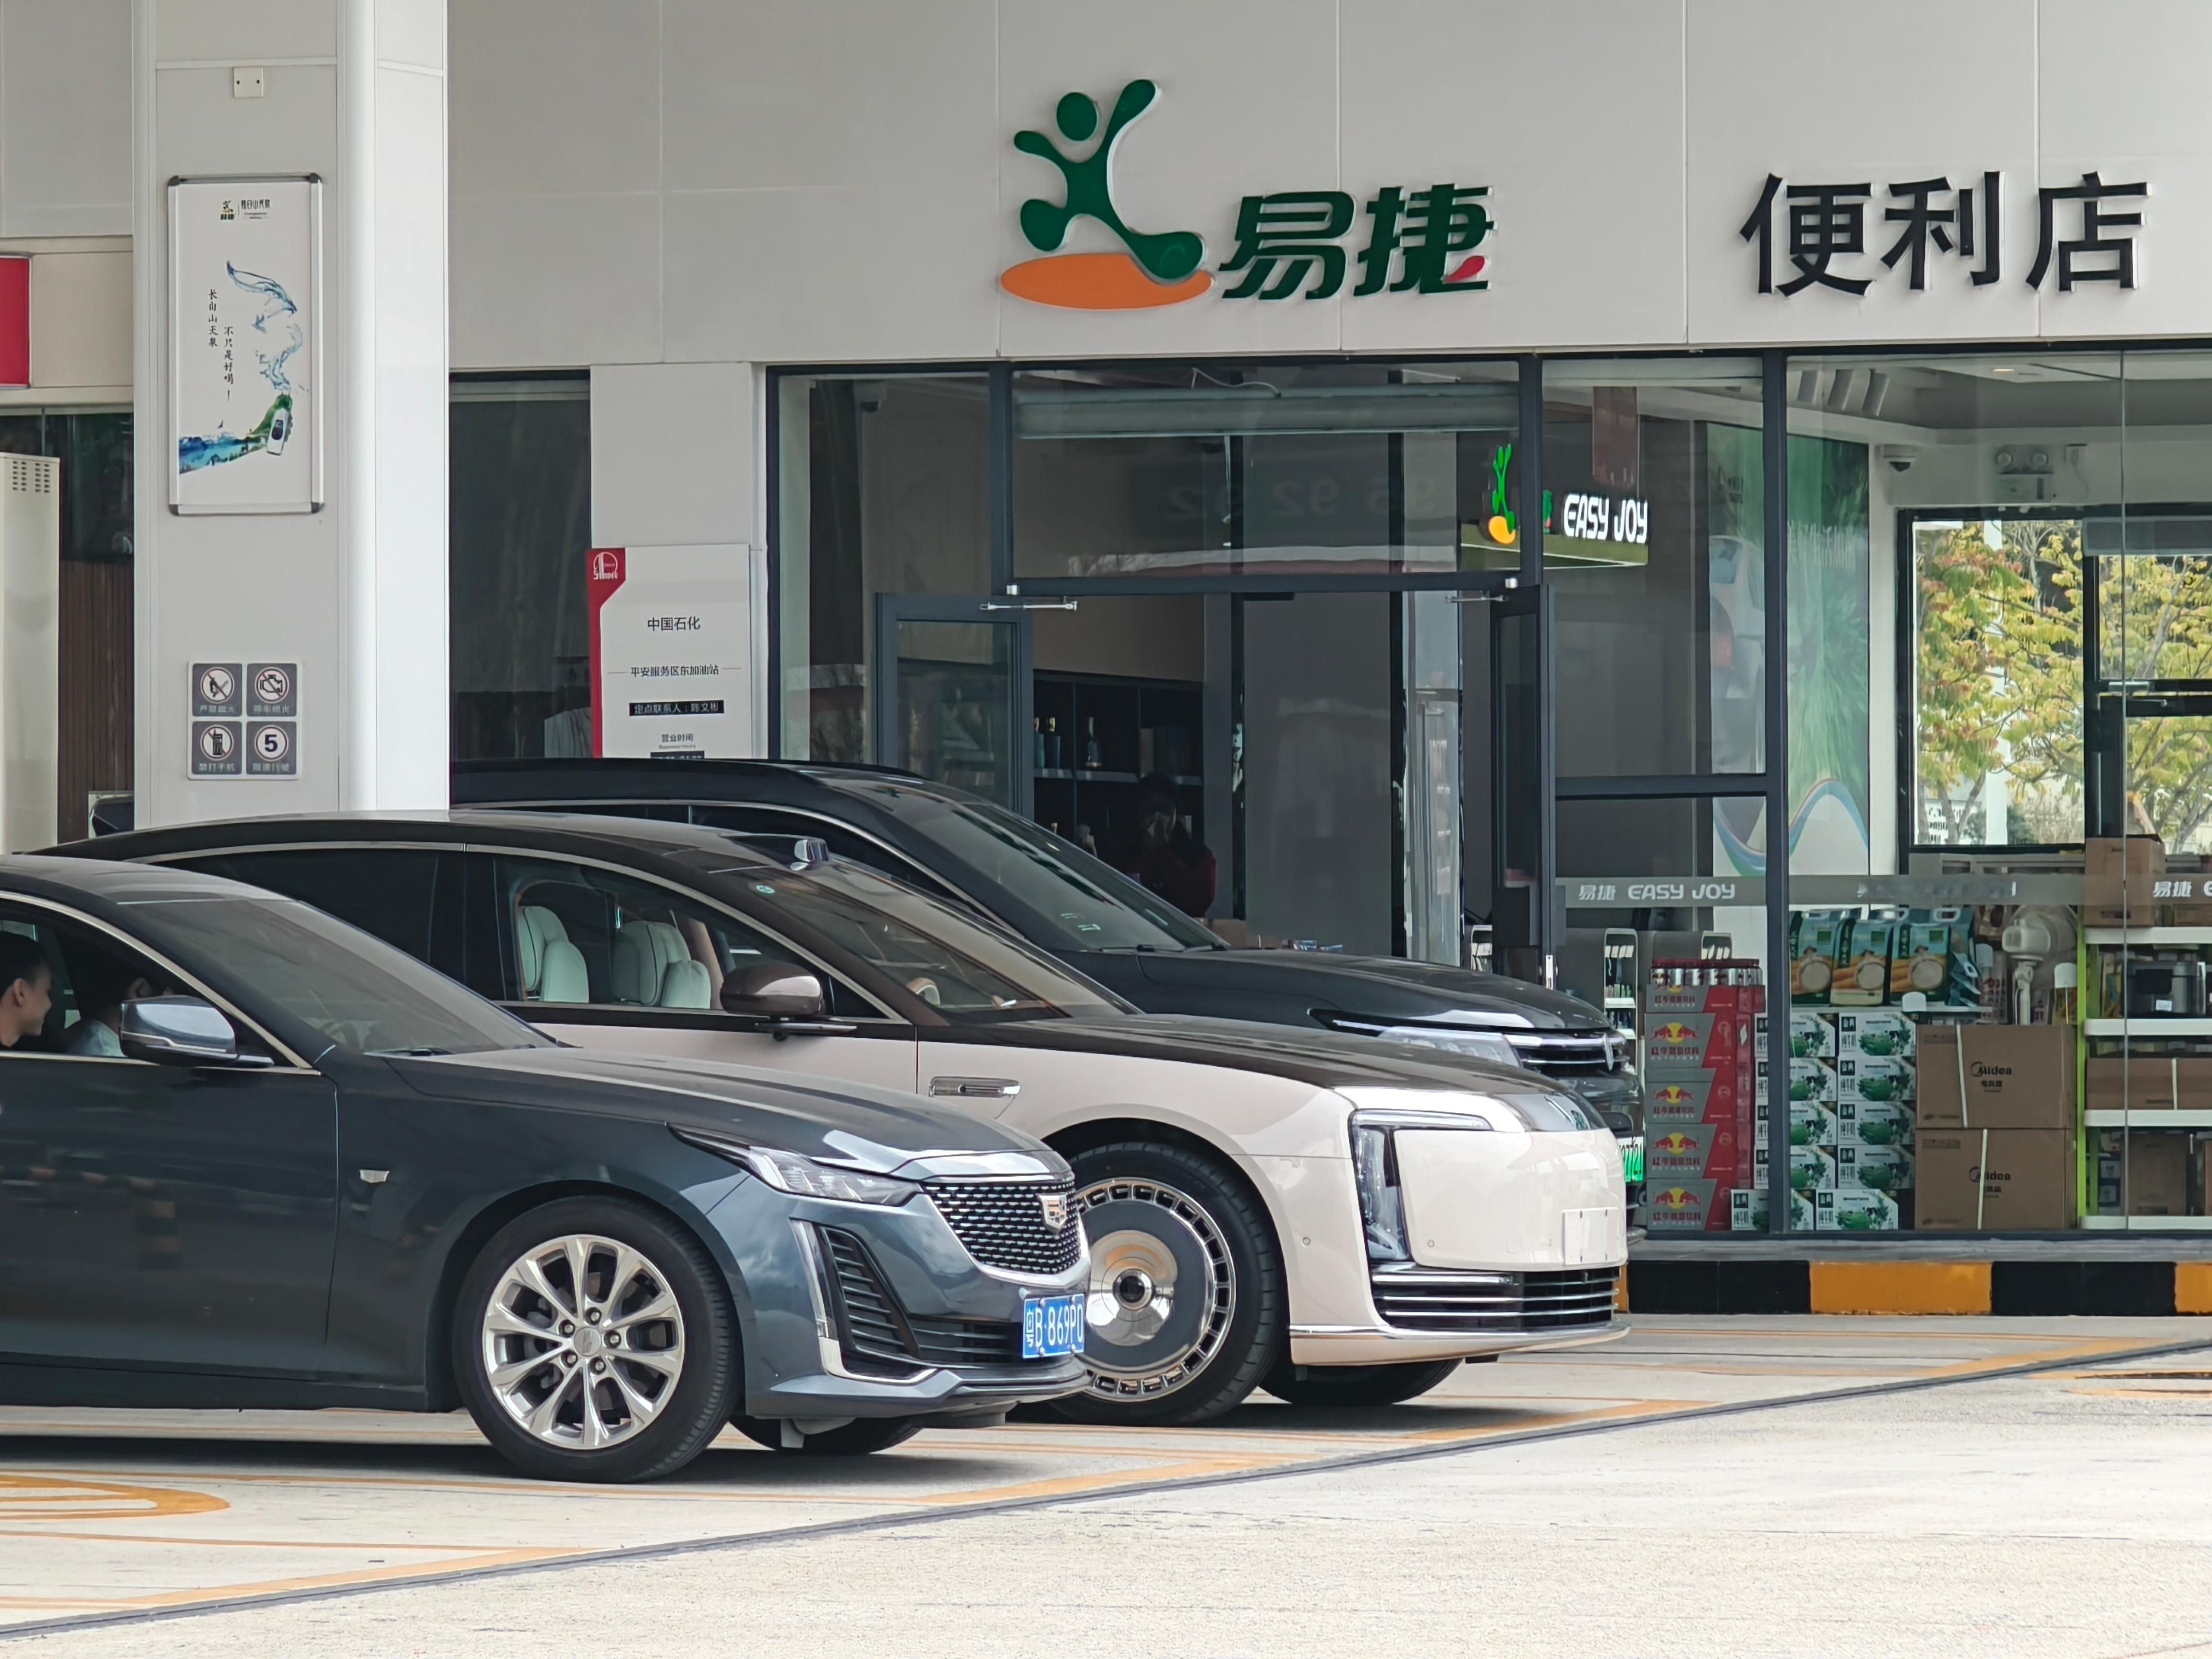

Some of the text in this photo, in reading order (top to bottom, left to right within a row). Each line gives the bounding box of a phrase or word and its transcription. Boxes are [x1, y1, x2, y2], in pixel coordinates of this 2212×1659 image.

[1218, 183, 1497, 300] 易捷
[1739, 170, 2152, 298] 便利店
[1563, 493, 1610, 540] EASY
[1614, 499, 1648, 544] JOY
[647, 616, 700, 631] 中国石化
[264, 734, 278, 752] 5
[1578, 883, 1735, 901] 易捷 EASY JOY
[2152, 881, 2192, 898] 易捷
[1972, 1062, 2012, 1077] Midea
